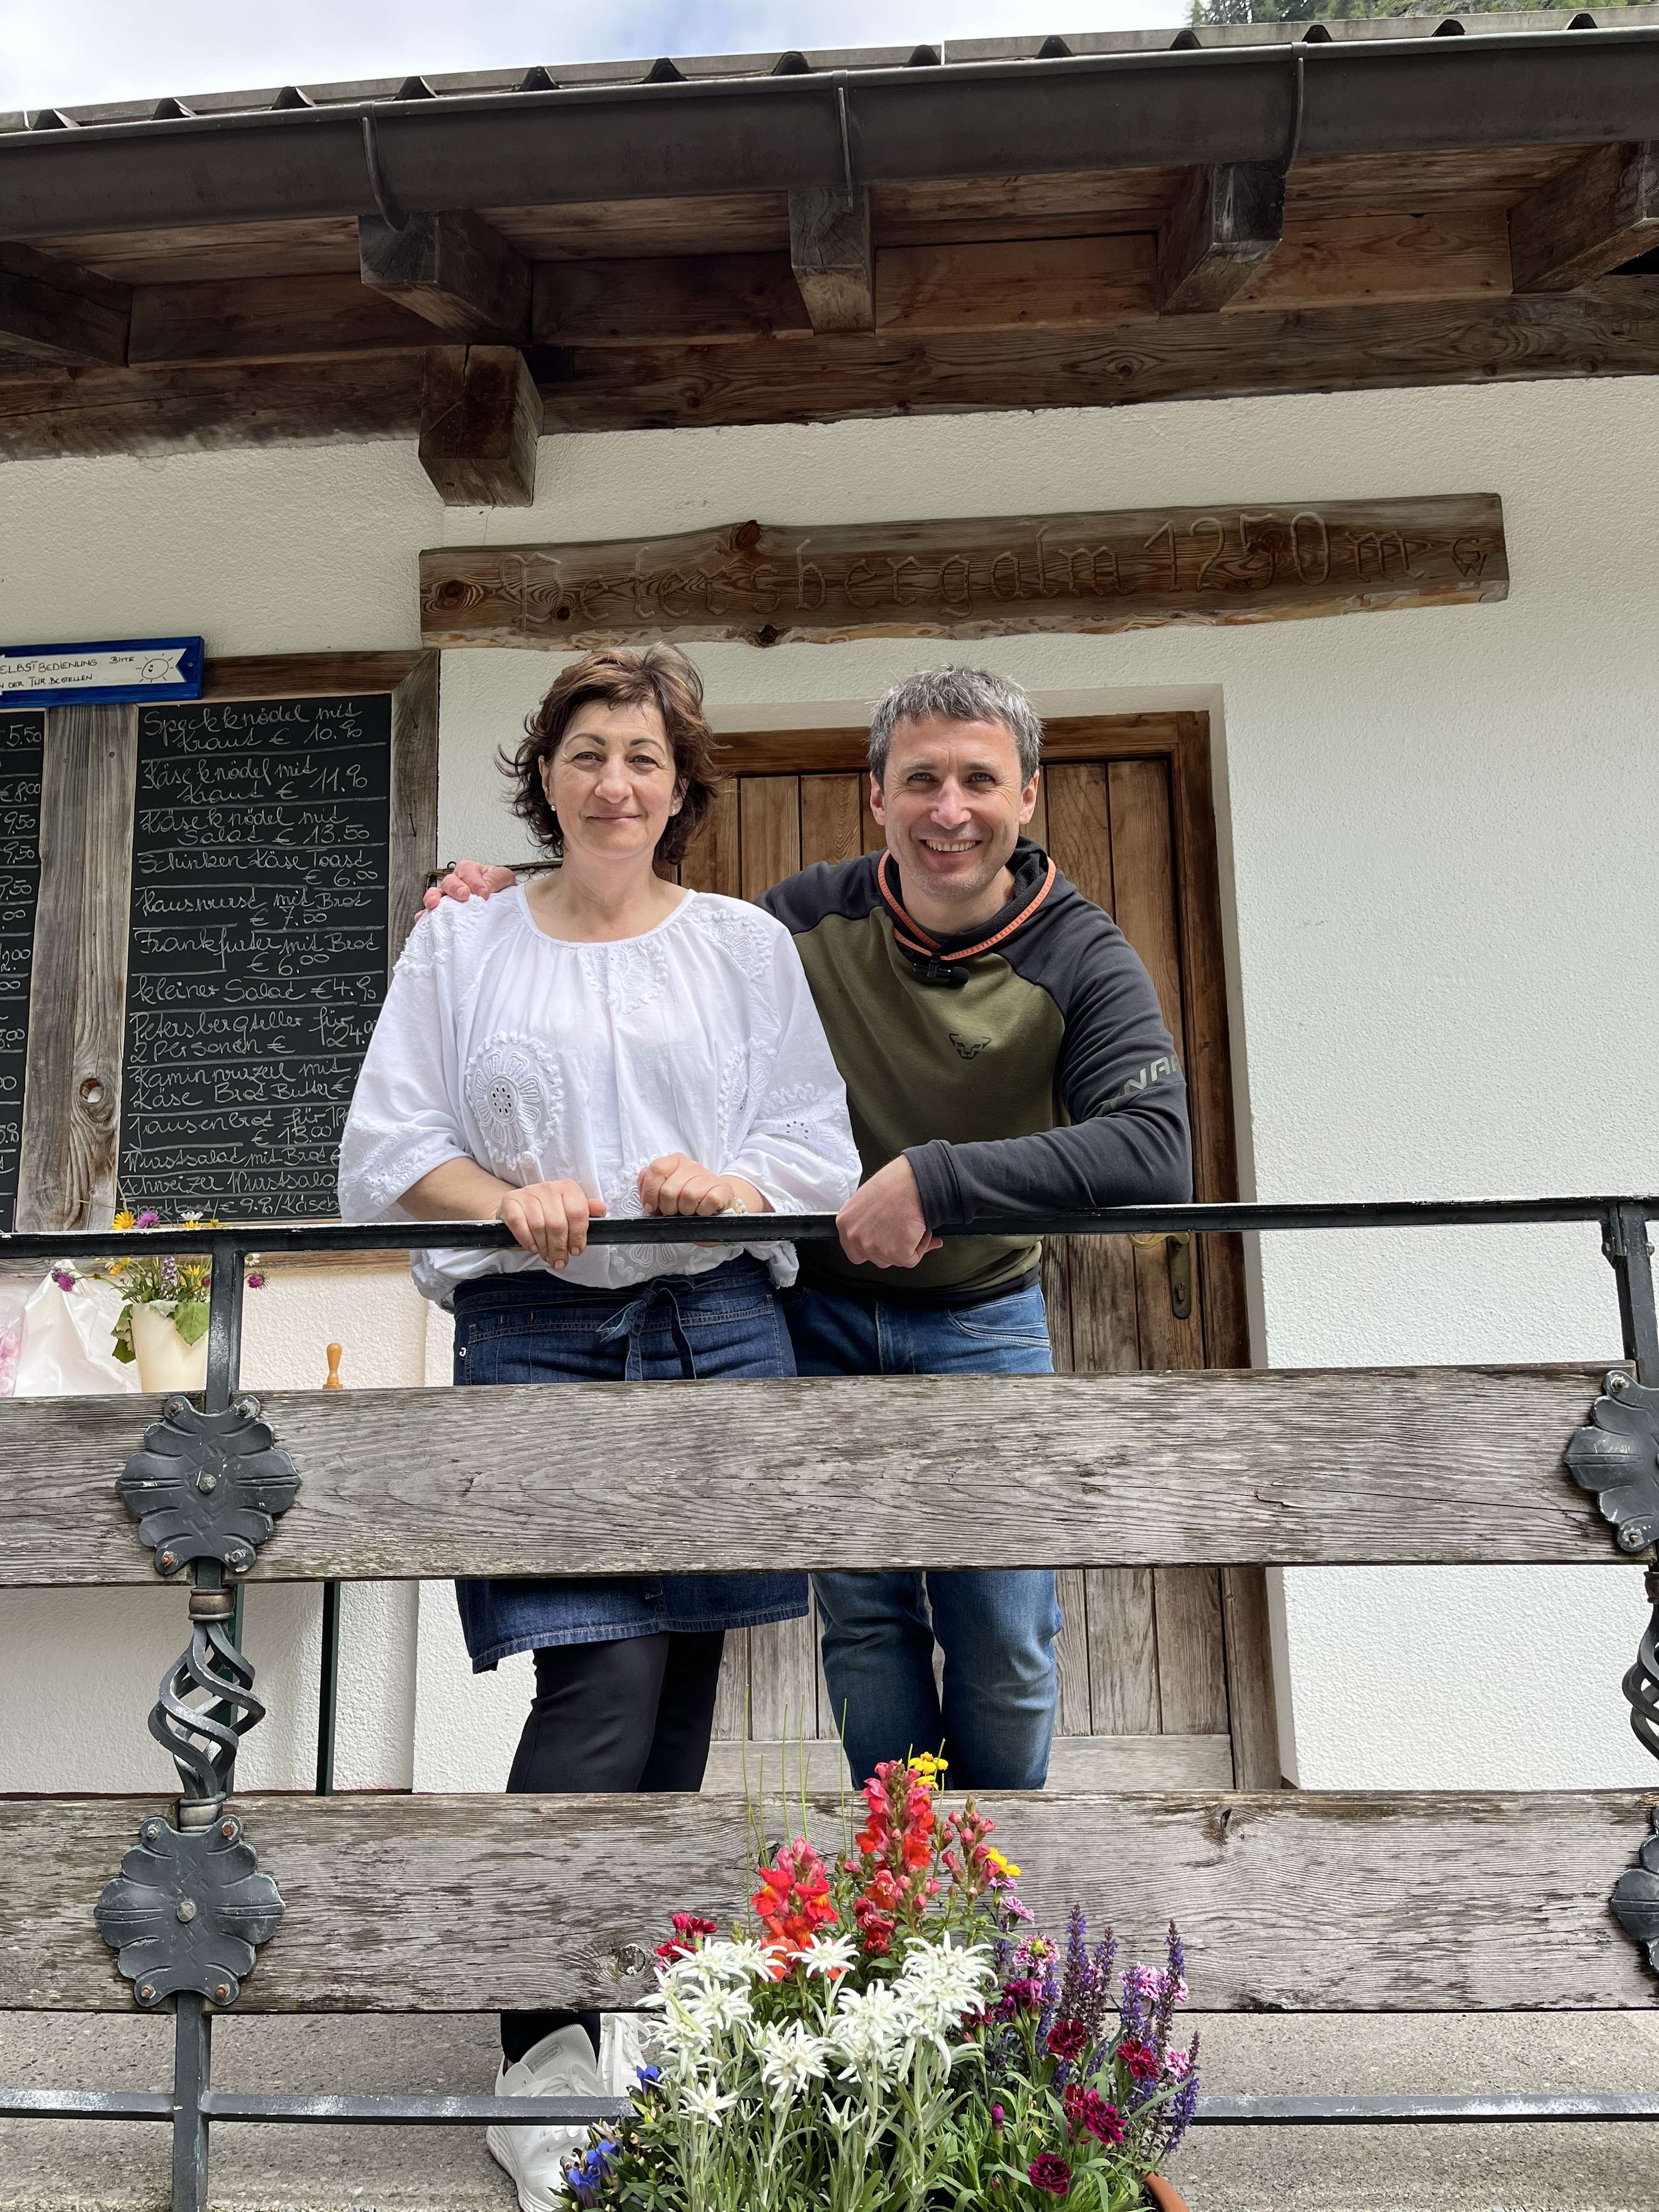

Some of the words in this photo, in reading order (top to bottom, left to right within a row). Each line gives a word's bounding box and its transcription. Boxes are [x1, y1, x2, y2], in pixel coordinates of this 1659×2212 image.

[1143, 510, 1331, 593] 1250
[1344, 530, 1426, 583] m
[0, 659, 98, 674] ELBSTBEDIENUNG
[315, 703, 362, 722] mit
[172, 727, 263, 754] Kraut
[269, 728, 291, 745] €
[274, 756, 319, 780] mit
[177, 781, 264, 804] Kraut
[274, 781, 299, 800] €
[298, 805, 349, 825] mit
[177, 825, 265, 846] Salat
[272, 828, 296, 845] €
[247, 848, 310, 871] Käse
[305, 848, 373, 868] Toast
[302, 869, 322, 885] €
[273, 888, 315, 907] mit
[314, 892, 372, 911] Brot
[249, 908, 269, 926] €
[279, 933, 325, 955] mit
[324, 932, 380, 952] Brot
[0, 943, 31, 972] 2.00
[246, 952, 269, 972] €
[222, 979, 306, 1003] Salat
[308, 1006, 355, 1046] für
[267, 1035, 296, 1054] €
[299, 1057, 352, 1077] mit
[130, 1087, 203, 1110] Käse
[214, 1082, 268, 1103] Brot
[270, 1080, 339, 1100] Butter
[331, 1075, 351, 1093] €
[282, 1107, 326, 1136] für
[251, 1129, 270, 1145] €
[244, 1150, 283, 1168] mit
[281, 1148, 328, 1166] Brot
[227, 1170, 338, 1193] Wurstsala
